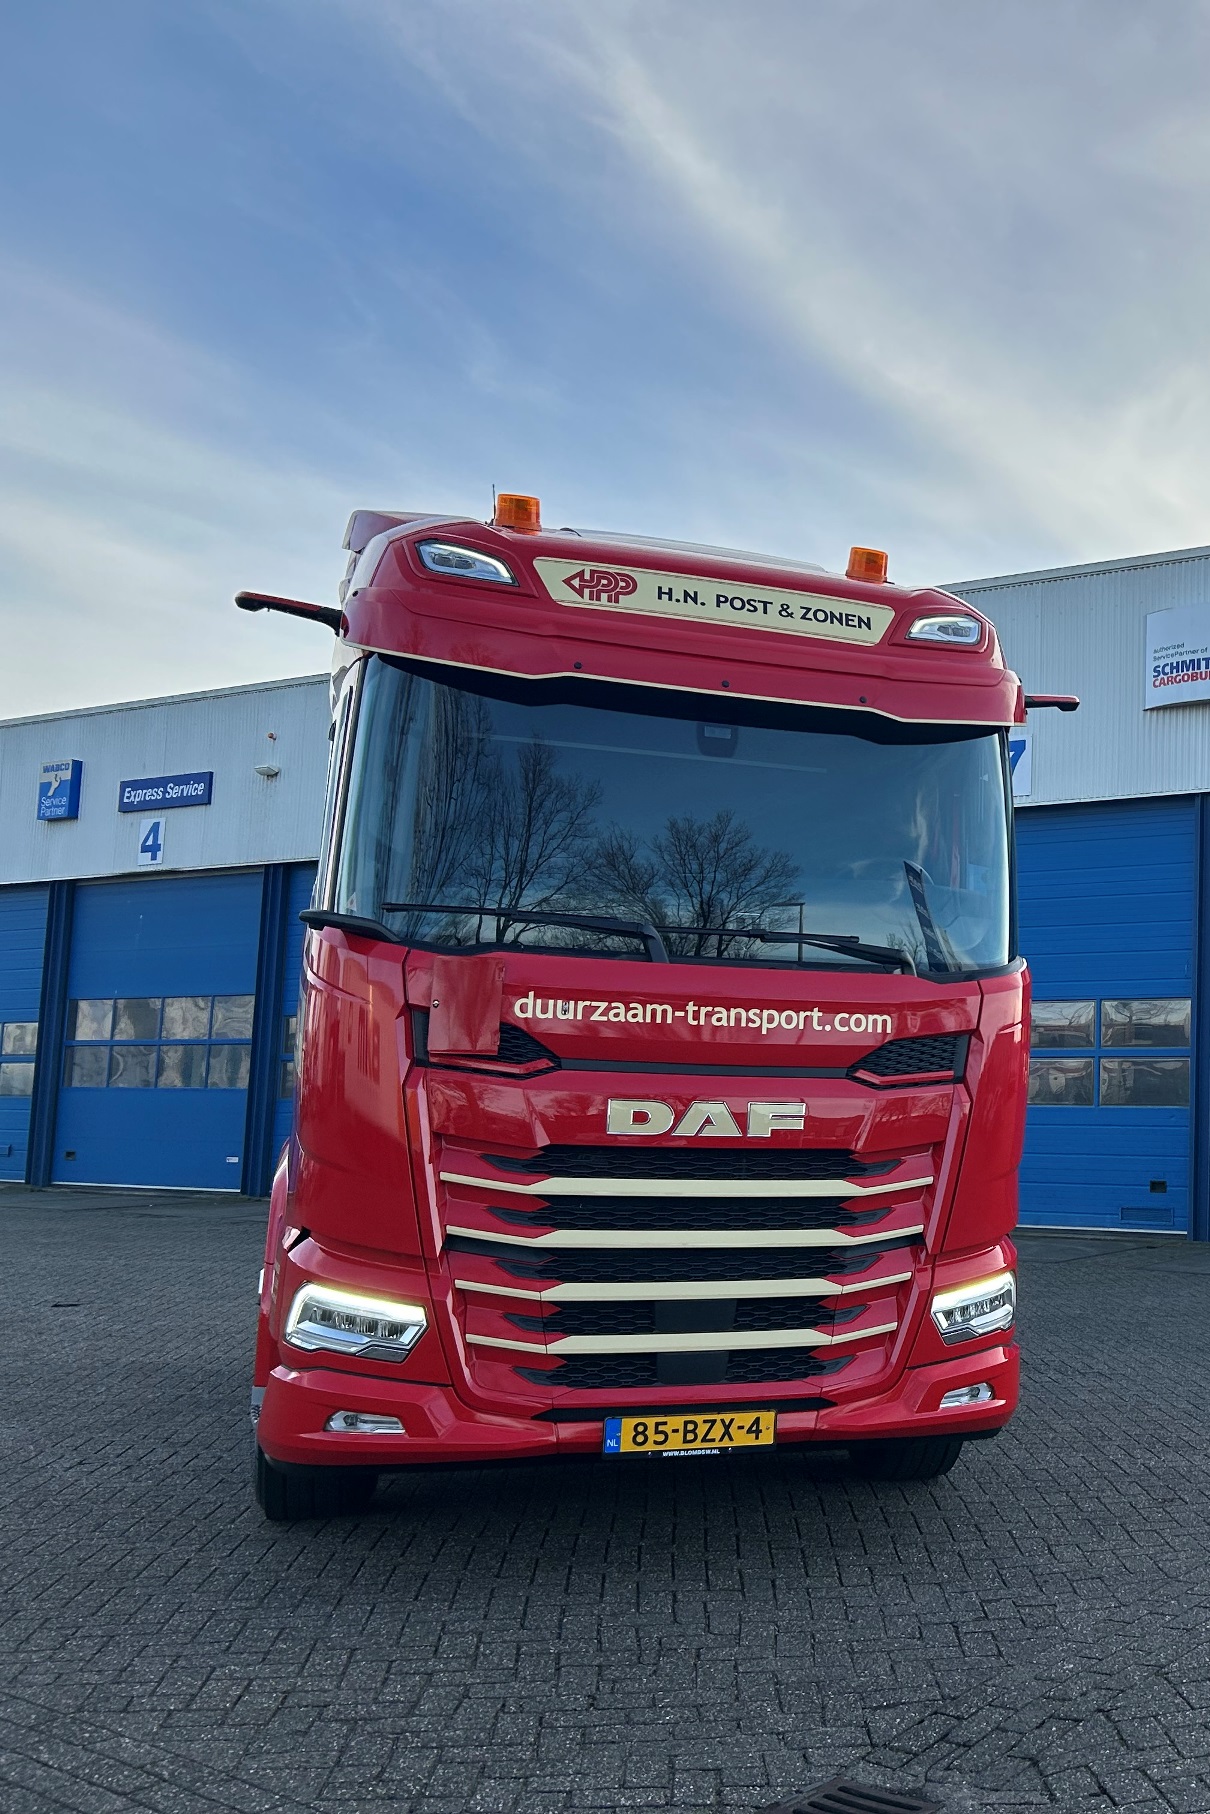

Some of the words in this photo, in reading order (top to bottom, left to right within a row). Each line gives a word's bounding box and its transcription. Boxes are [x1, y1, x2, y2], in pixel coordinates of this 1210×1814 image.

[657, 585, 706, 607] H.N.
[715, 593, 773, 615] POST
[778, 603, 795, 619] &
[799, 605, 872, 631] ZONEN
[1153, 642, 1185, 654] authorized
[42, 762, 71, 774] WABCO
[40, 796, 67, 807] Service
[123, 787, 164, 805] Express
[165, 780, 205, 798] Service
[40, 806, 66, 817] Partner
[140, 821, 162, 861] 4
[514, 991, 892, 1035] duurzaam-transport.com
[606, 1098, 807, 1138] DAF
[606, 1439, 618, 1448] NL
[631, 1416, 763, 1447] 85-BZX-4
